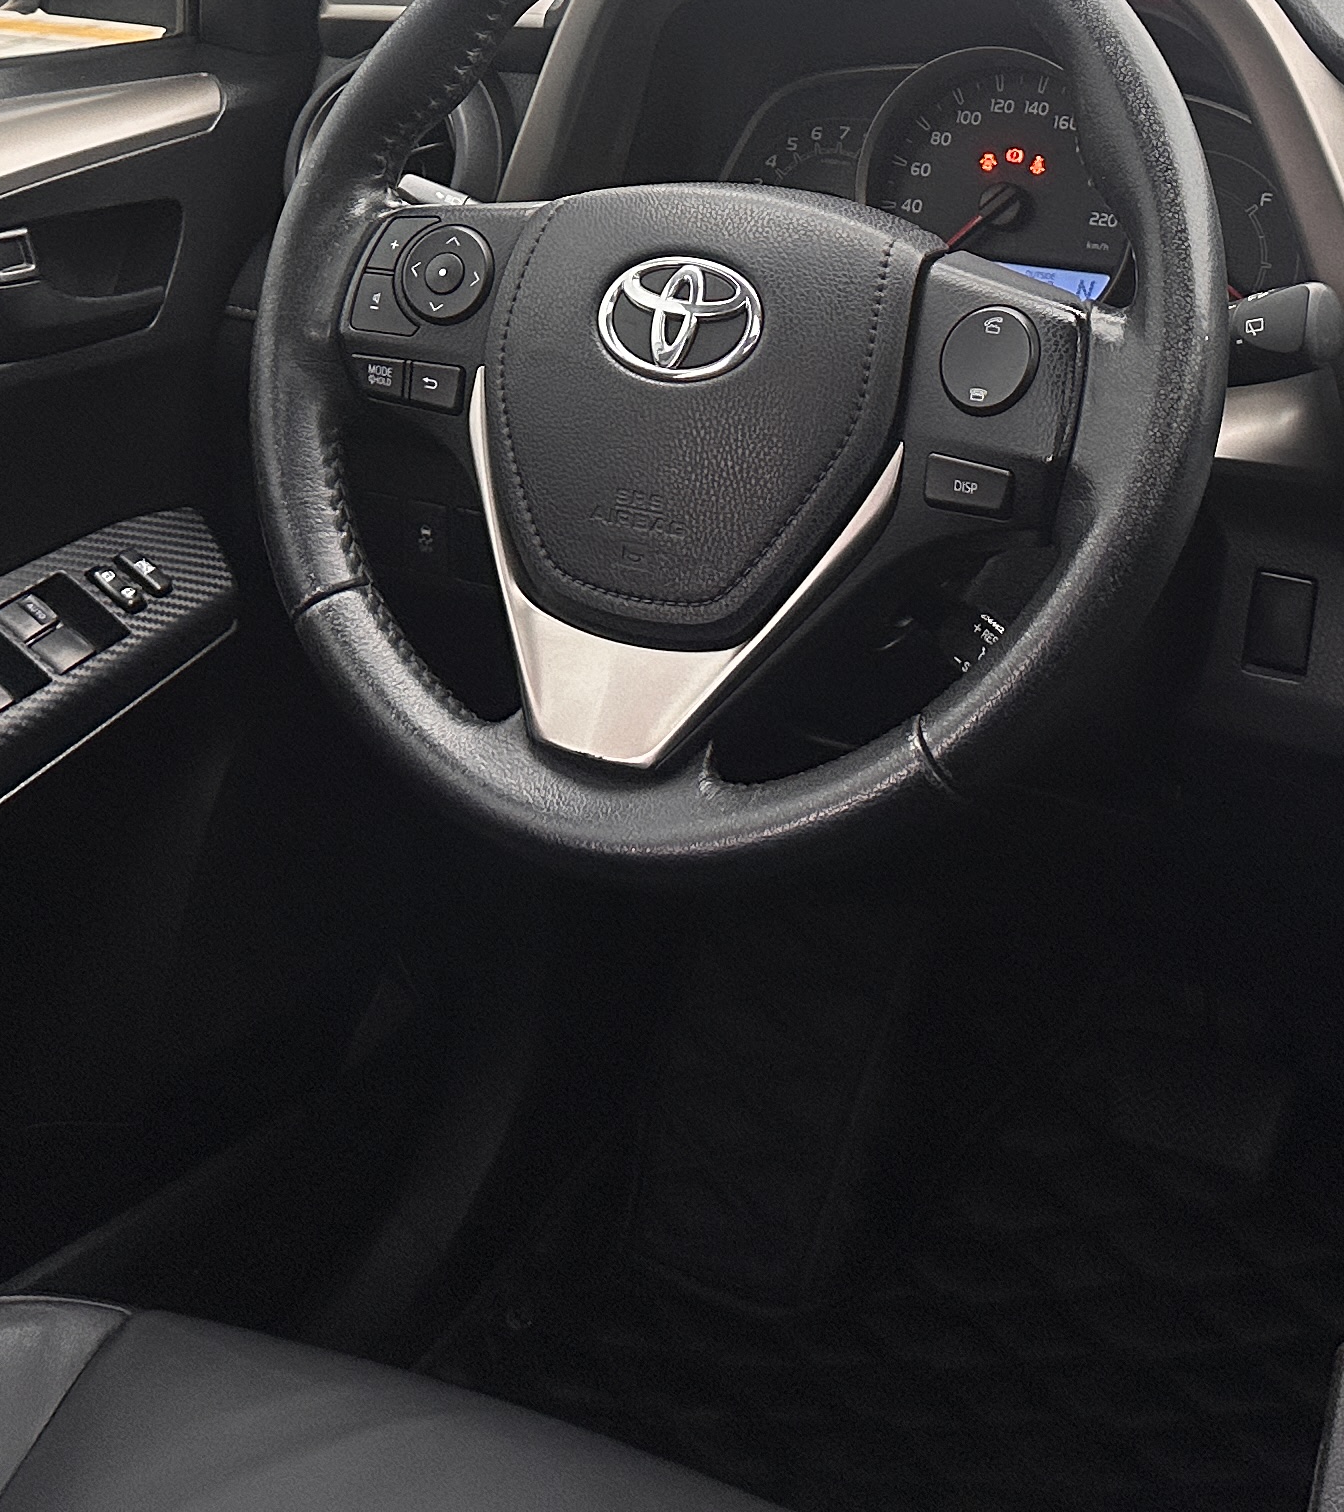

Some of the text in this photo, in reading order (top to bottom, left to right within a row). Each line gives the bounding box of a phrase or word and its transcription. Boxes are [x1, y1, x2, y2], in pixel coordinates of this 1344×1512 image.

[990, 98, 1015, 114] 120
[1024, 100, 1049, 116] 140
[956, 110, 982, 125] 100
[810, 126, 823, 140] 6
[839, 125, 851, 140] 7
[930, 131, 952, 147] 80
[785, 137, 799, 151] 5
[765, 154, 778, 168] 4
[910, 162, 931, 177] 60
[901, 198, 923, 214] 40
[1259, 192, 1274, 207] F
[1088, 211, 1118, 228] 220
[1086, 240, 1110, 252] km/h
[368, 363, 393, 378] MODE
[953, 479, 979, 495] DISP
